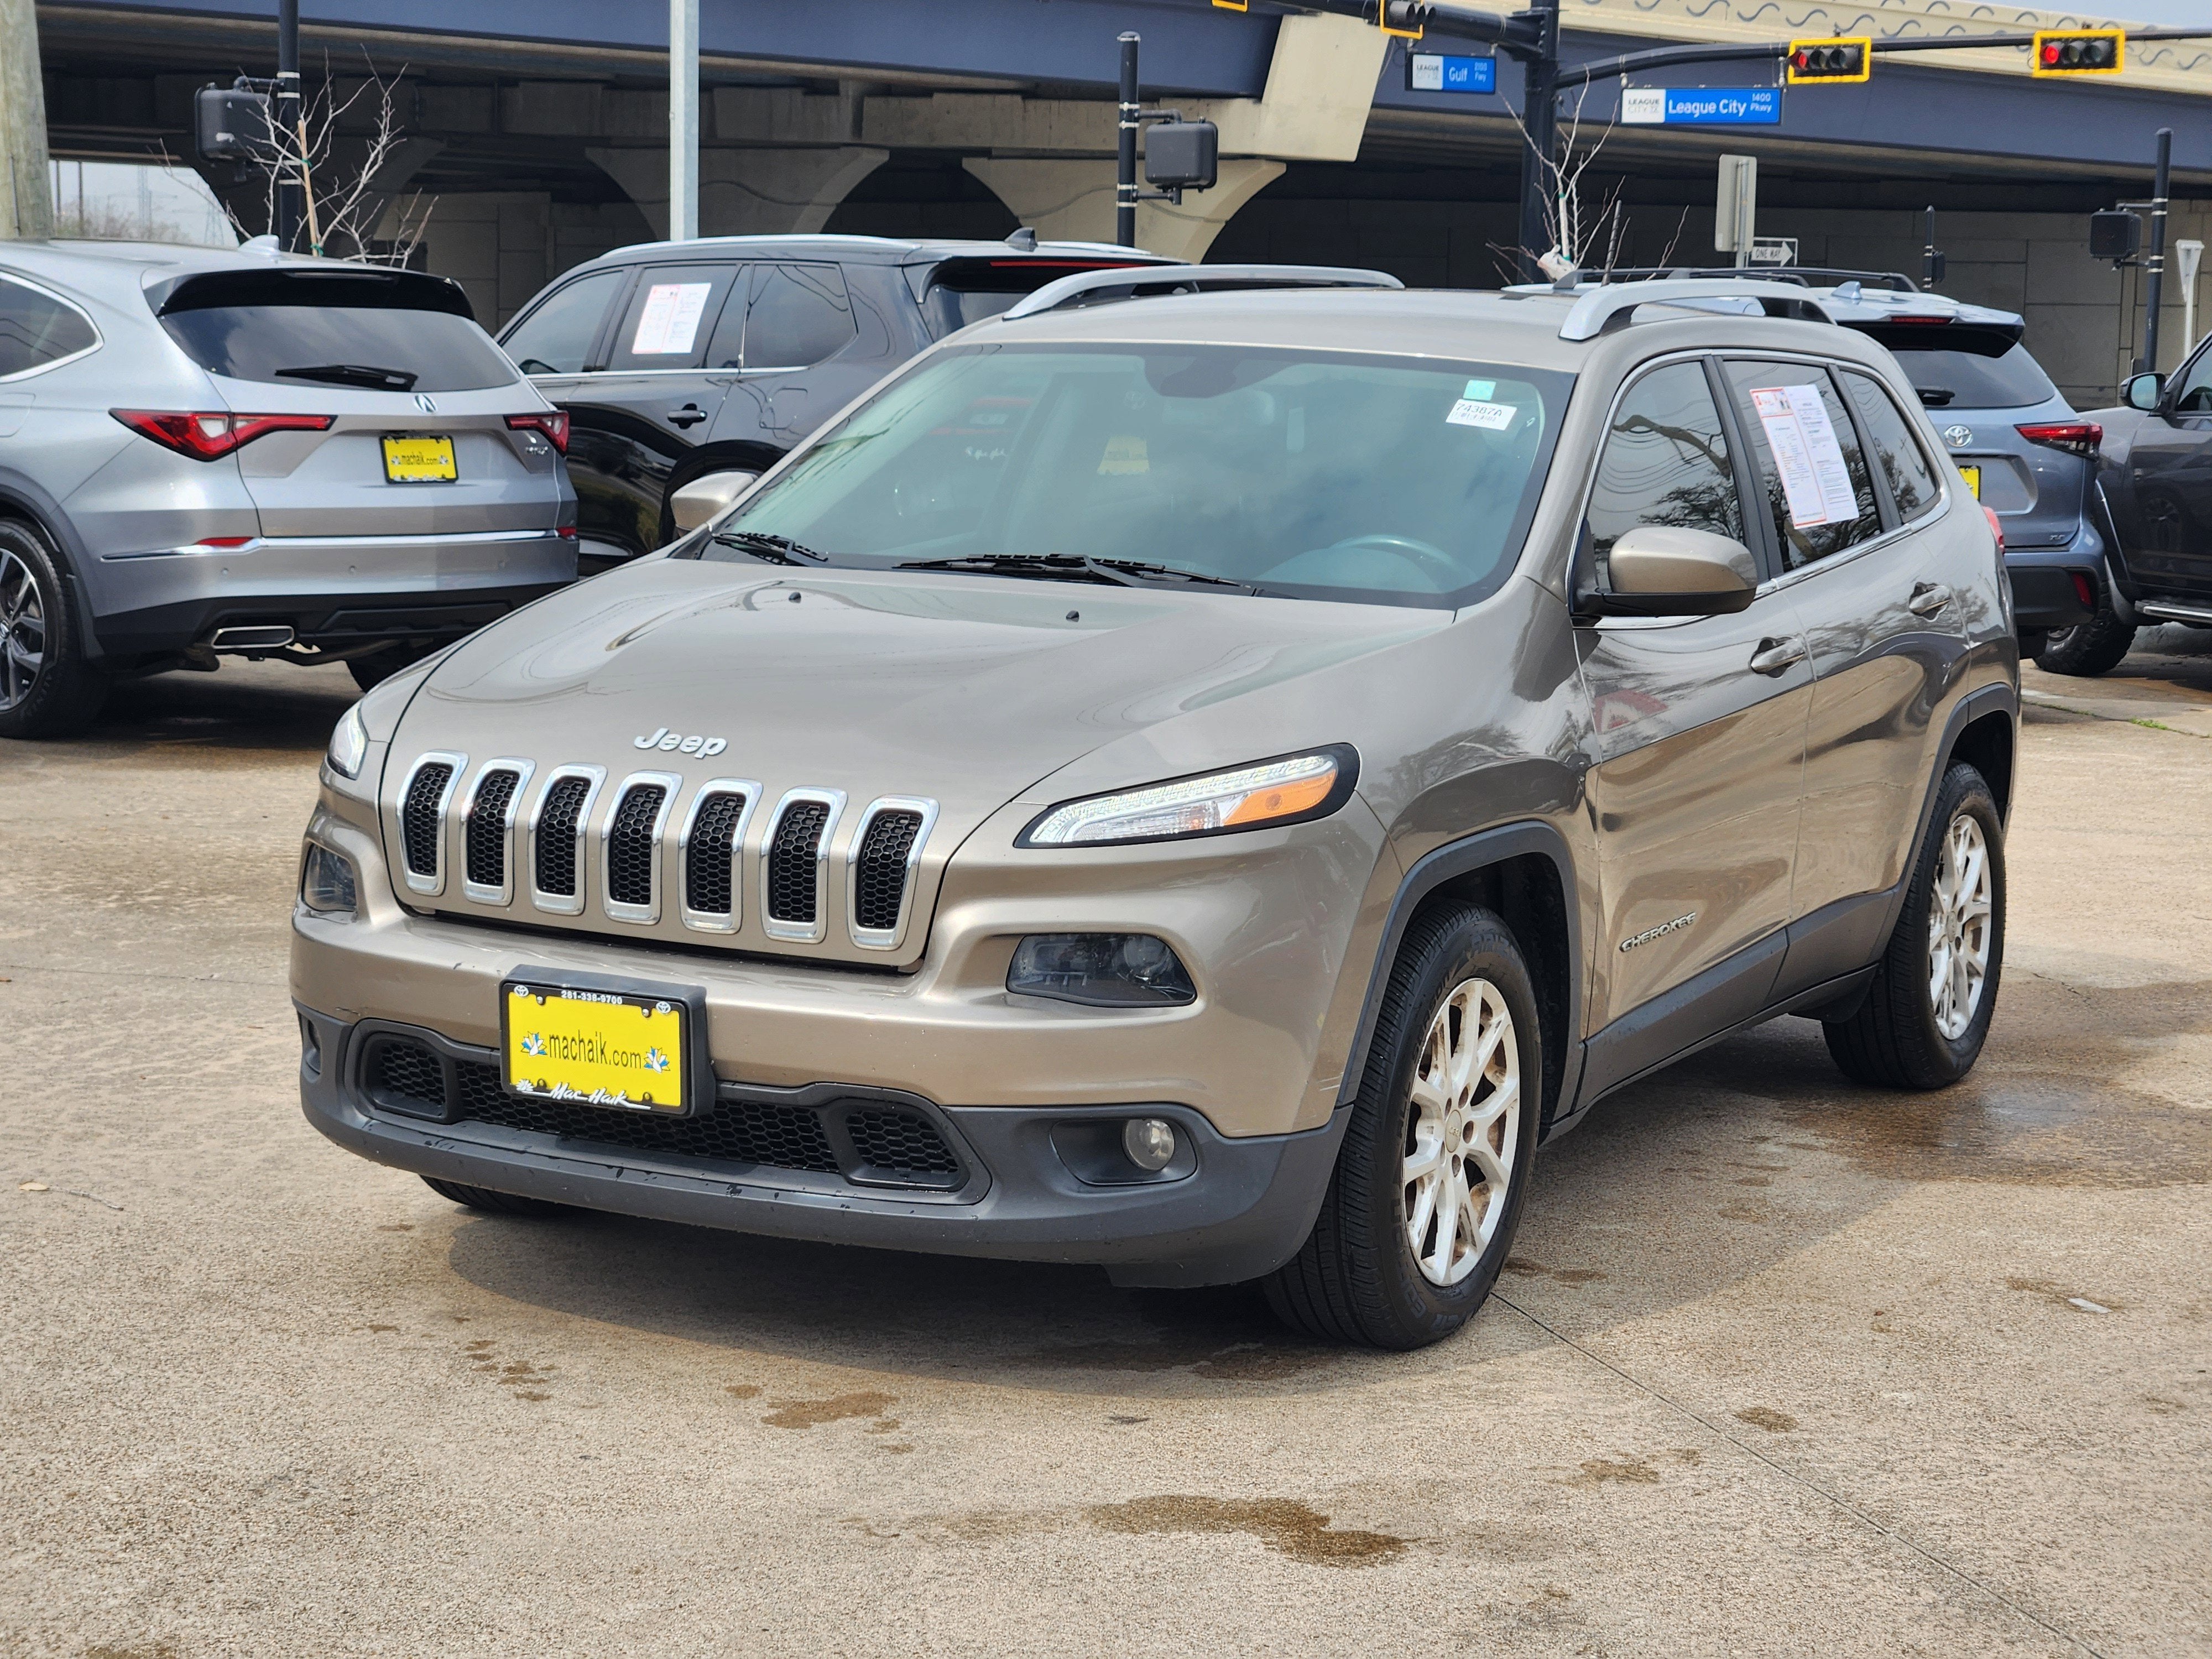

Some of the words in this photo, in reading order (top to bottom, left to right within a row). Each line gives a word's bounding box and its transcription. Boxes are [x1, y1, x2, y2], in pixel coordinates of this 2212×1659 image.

[1449, 66, 1468, 82] Gulf
[1752, 92, 1771, 102] 1400
[1668, 99, 1717, 118] League
[1719, 98, 1747, 117] City
[1750, 102, 1772, 113] Pkwy
[1756, 248, 1767, 259] ONE
[1770, 248, 1781, 259] WAY
[1456, 403, 1502, 416] 74387A
[634, 727, 728, 760] Jeep
[1619, 911, 1696, 952] CHEROKEE
[561, 990, 623, 1005] 281-338-9700
[549, 1030, 641, 1069] machaik.com
[550, 1081, 588, 1100] Mac
